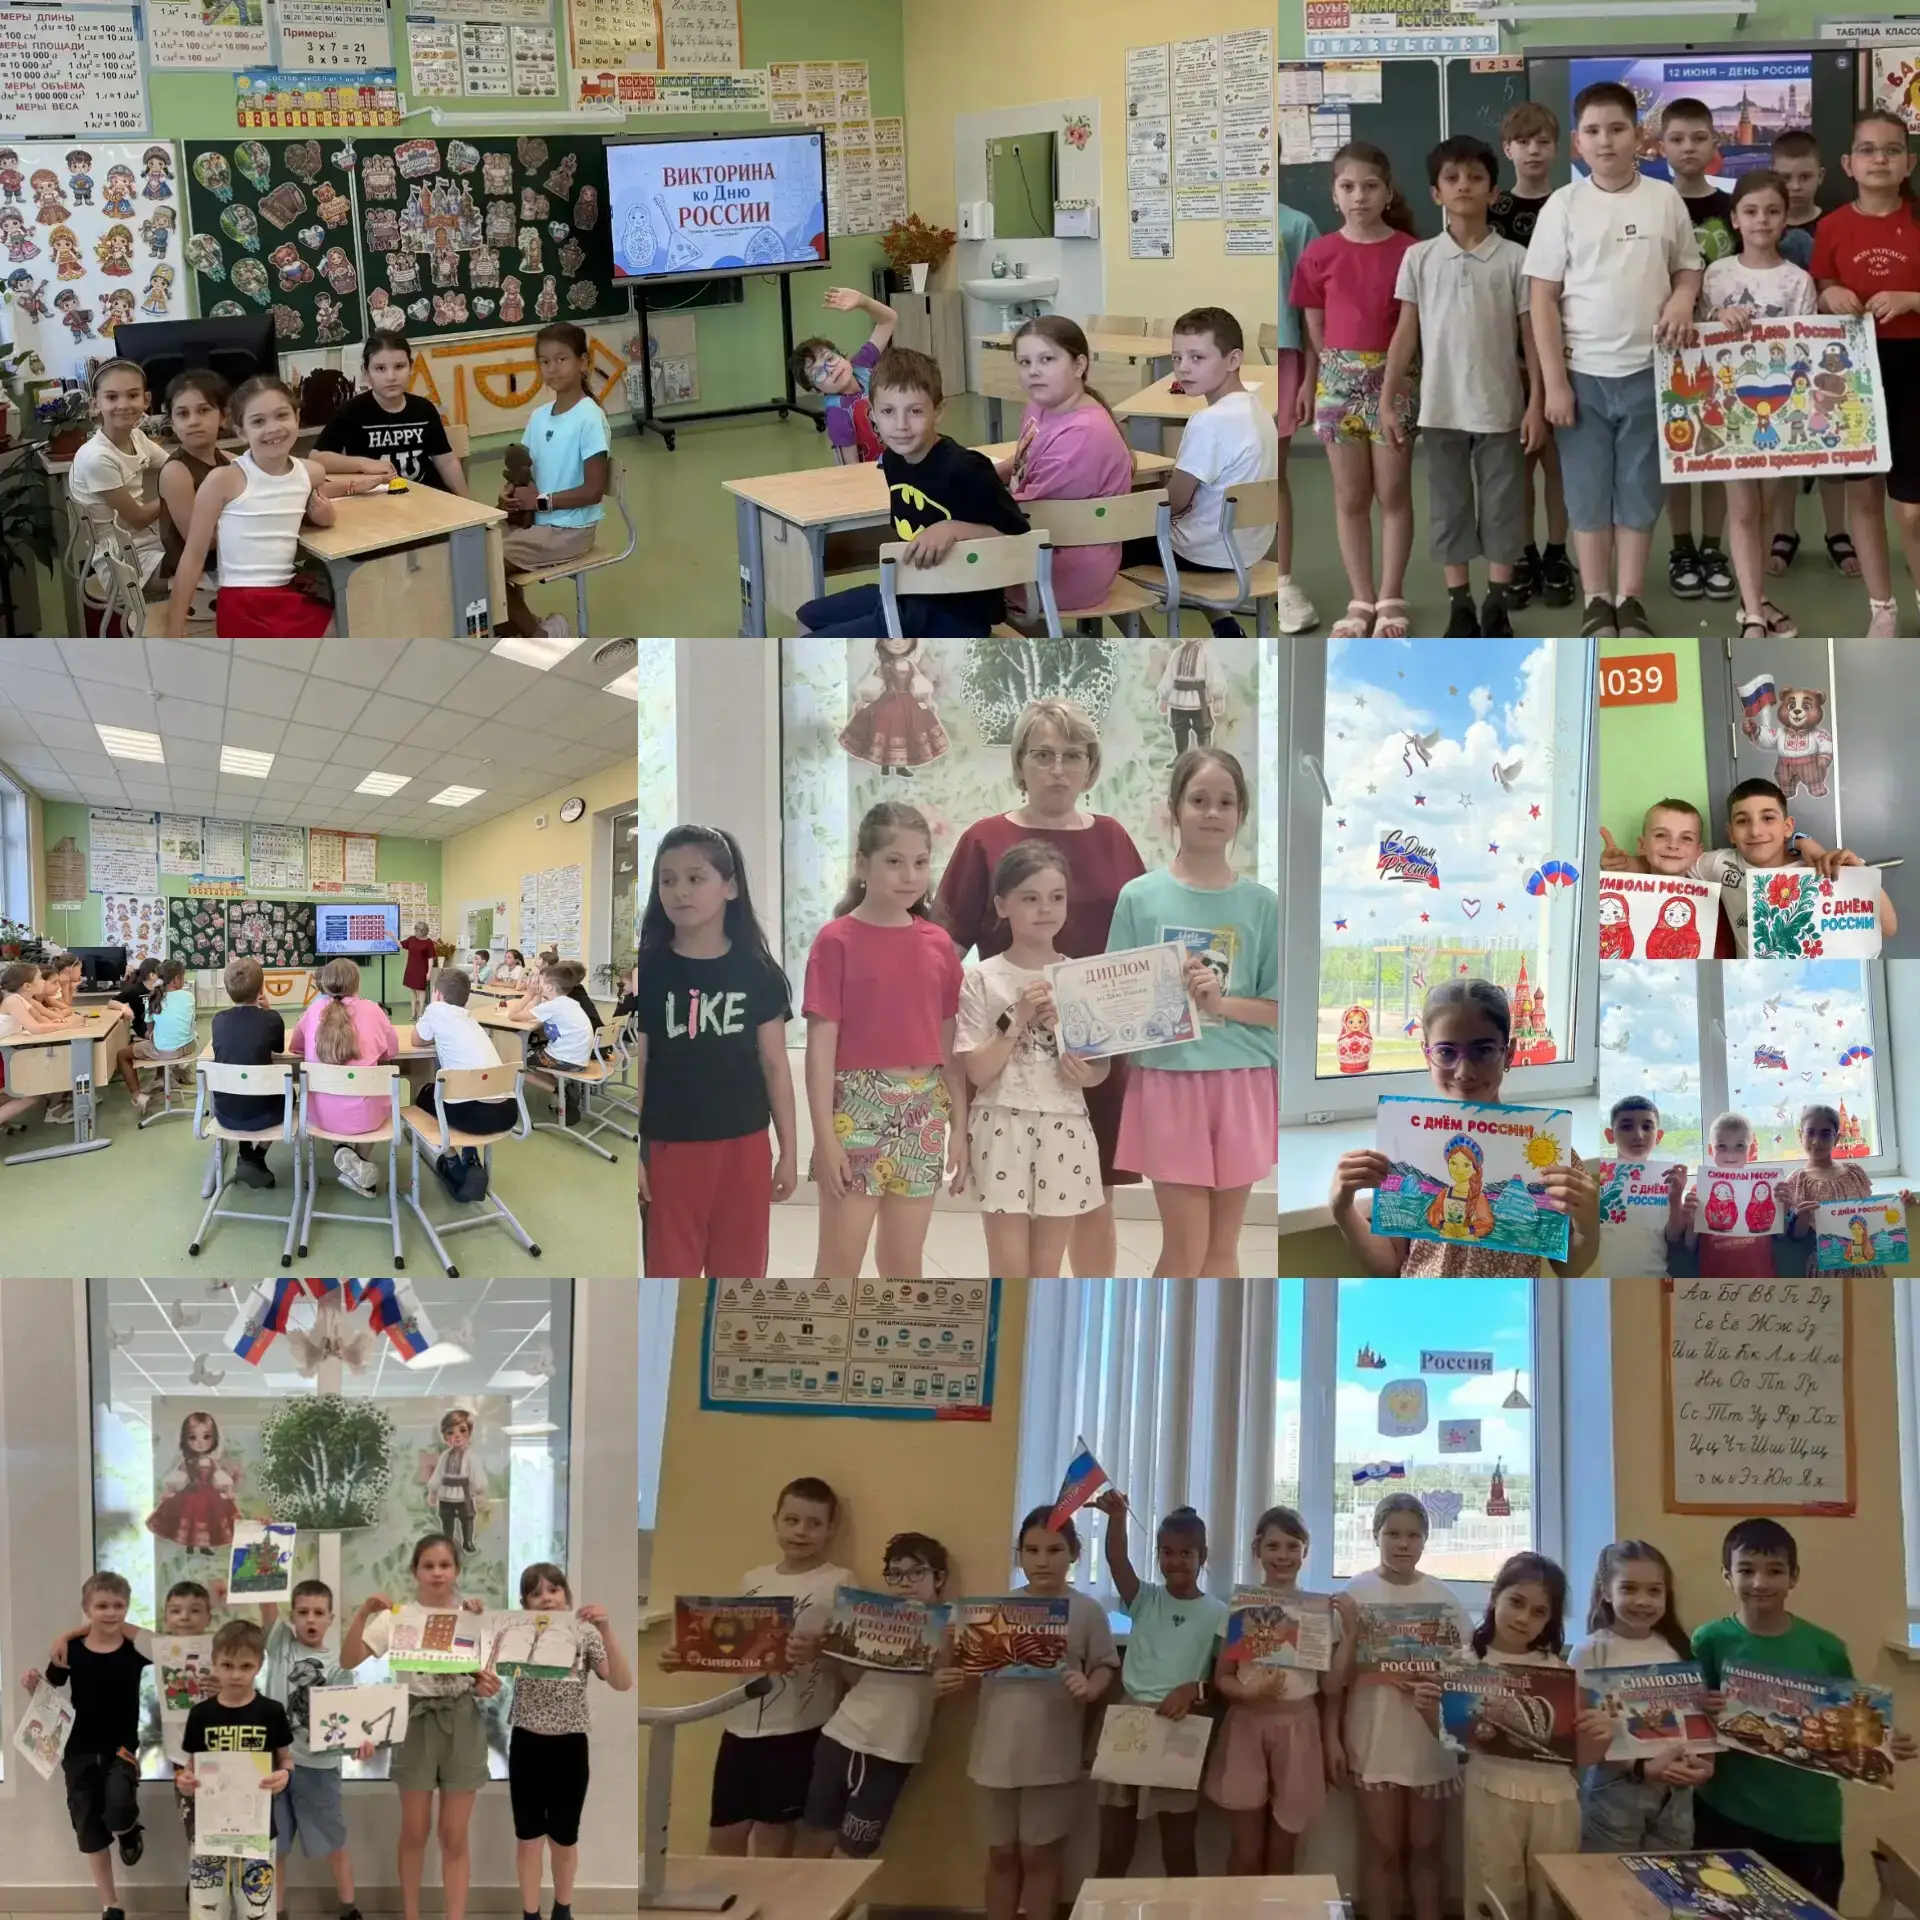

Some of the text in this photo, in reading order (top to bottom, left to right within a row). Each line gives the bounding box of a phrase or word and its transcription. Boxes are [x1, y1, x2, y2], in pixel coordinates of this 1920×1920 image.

[0, 13, 75, 22] МЕРЫ ДЛИНЫ
[283, 28, 337, 39] Примеры:
[1836, 28, 1880, 36] ТАБЛИЦА
[32, 42, 84, 51] ПЛОЩАДИ
[308, 42, 313, 51] 3
[330, 43, 336, 51] 7
[354, 44, 366, 52] 21
[332, 56, 338, 64] 9
[355, 56, 367, 64] 72
[1475, 59, 1523, 70] 1 2 3 4
[1668, 65, 1810, 78] 12 ИЮНЯ ДЕНЬ РОССИИ
[4, 81, 85, 90] МЕРЫ ОБЪЁМА
[16, 103, 47, 111] МЕРЫ
[662, 162, 776, 187] ВИКТОРИНА
[693, 185, 750, 203] ко Дню
[678, 202, 771, 228] РОССИИ
[368, 428, 424, 448] HAPPY
[1673, 456, 1684, 474] Я
[1600, 666, 1663, 696] 1039
[1384, 829, 1436, 860] С Днем
[1659, 881, 1708, 897] РОССИИ
[1822, 898, 1874, 916] С ДНЁМ
[1821, 916, 1874, 932] РОССИИ
[1085, 959, 1151, 984] ДИПЛОМ
[1410, 1115, 1534, 1138] С ДНЁМ РОССИИ!
[1708, 1170, 1778, 1180] СИМВОЛЫ РОССИИ
[1630, 1184, 1669, 1195] С ДНЁМ
[1626, 1196, 1669, 1206] РОССИИ
[1422, 1352, 1493, 1372] Россия
[859, 1630, 911, 1646] РОССИИ
[1008, 1624, 1068, 1636] РОССИИ
[1380, 1661, 1436, 1672] РОССИИ
[1620, 1672, 1702, 1690] СИМВОЛЫ
[1726, 1666, 1828, 1696] НАЦИОНАЛЬНЫЕ
[1444, 1681, 1516, 1698] СИМВОЛЫ
[842, 1812, 882, 1842] NYC
